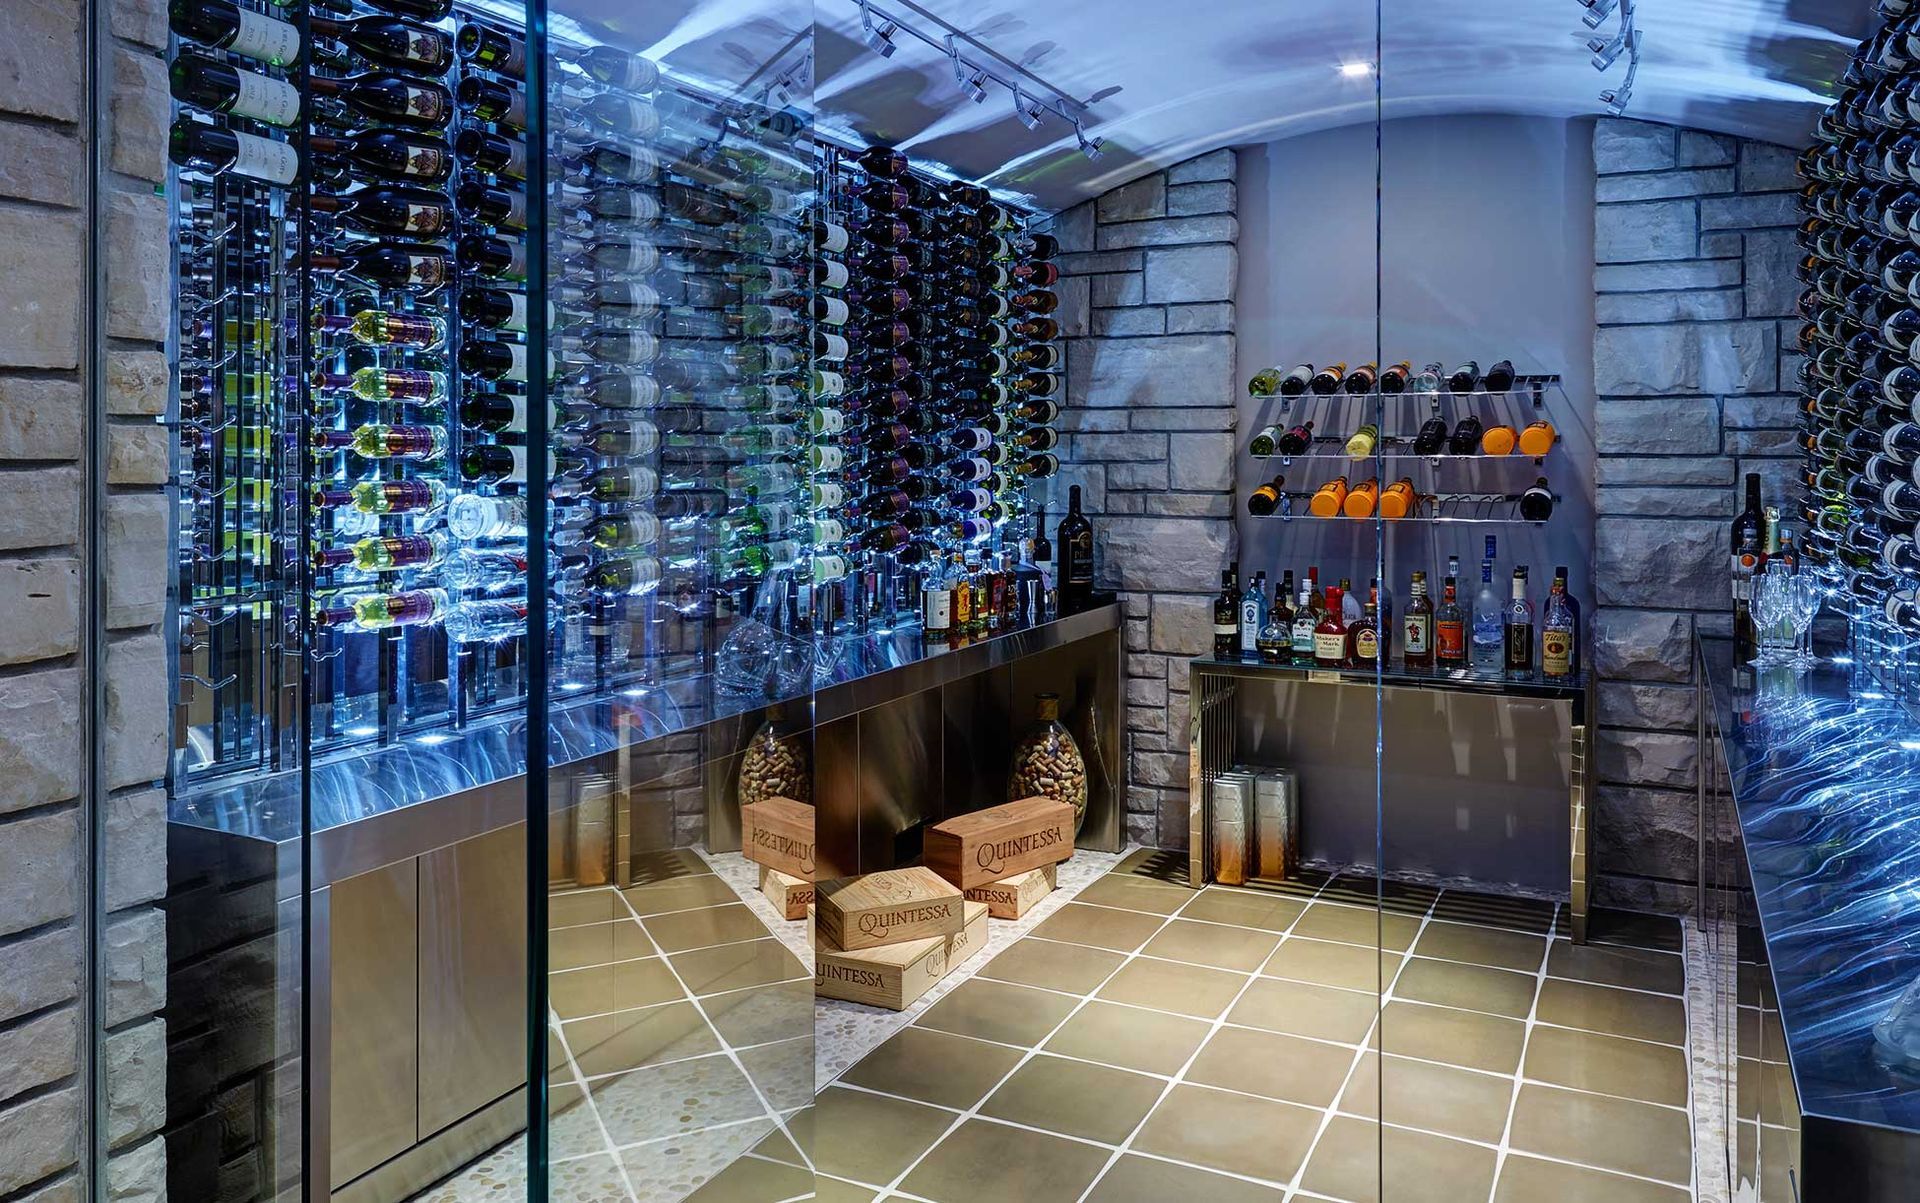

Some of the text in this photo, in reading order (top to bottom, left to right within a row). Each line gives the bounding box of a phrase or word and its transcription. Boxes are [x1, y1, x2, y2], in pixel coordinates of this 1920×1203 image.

[977, 827, 1062, 874] QUINTESSA
[963, 888, 1014, 904] INTESSA
[858, 904, 951, 938] QUINTESSA
[815, 962, 884, 988] UINTESSA
